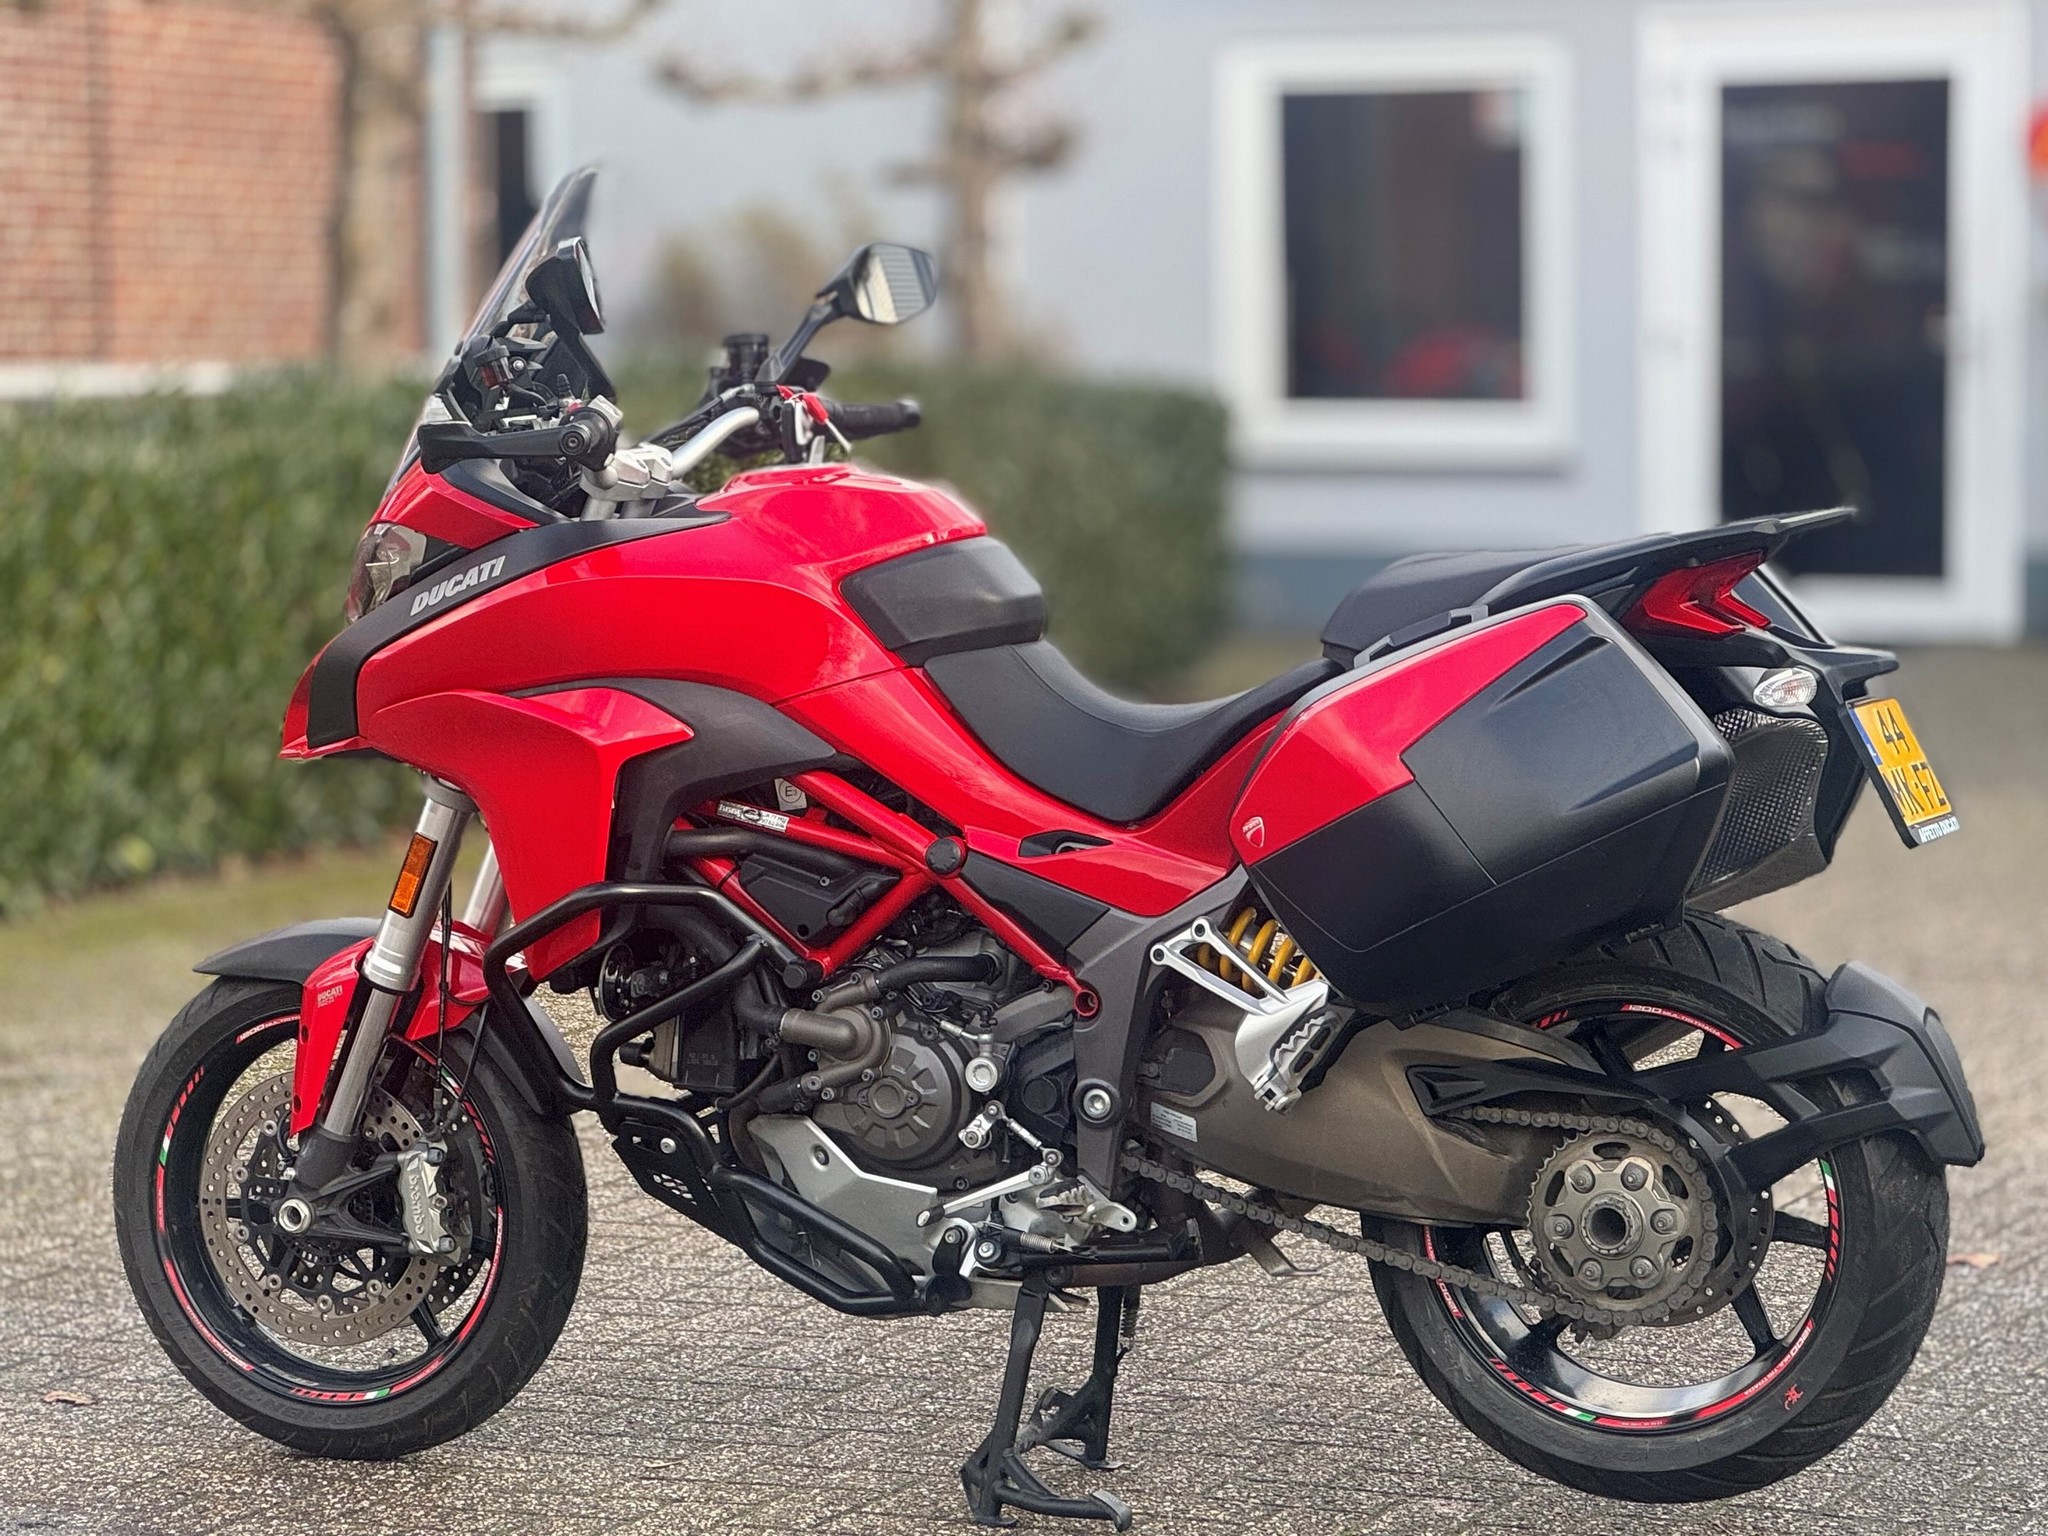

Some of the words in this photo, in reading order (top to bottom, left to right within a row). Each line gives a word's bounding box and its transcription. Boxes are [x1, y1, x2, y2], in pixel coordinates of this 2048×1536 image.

[410, 555, 506, 617] DUCATI
[1876, 706, 1911, 755] 44
[317, 985, 343, 1002] DUCATI
[1629, 1004, 1663, 1015] 1200
[239, 1023, 266, 1041] 1200
[408, 1174, 425, 1234] brembo
[1790, 1326, 1812, 1358] 1200
